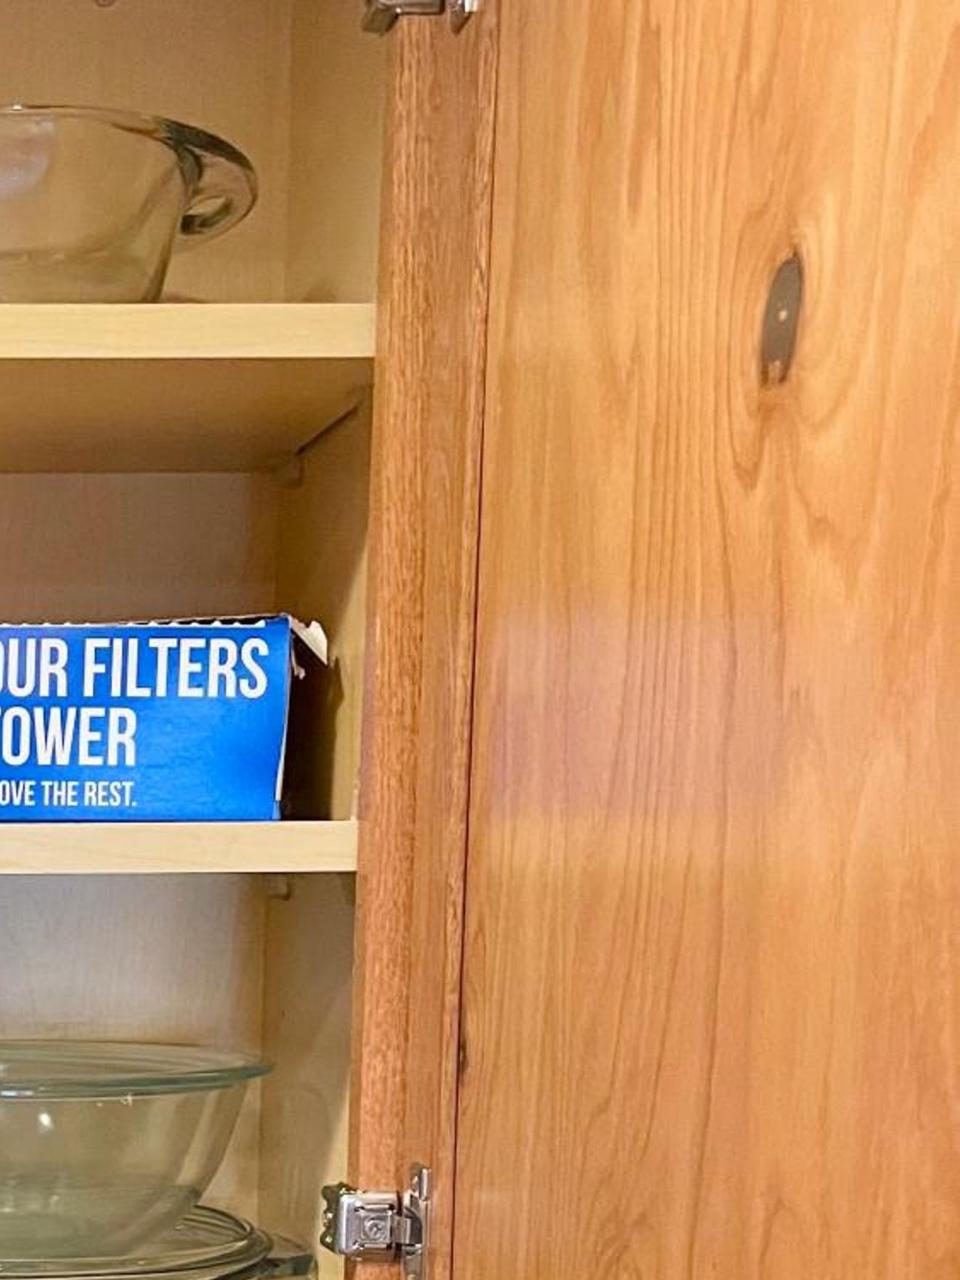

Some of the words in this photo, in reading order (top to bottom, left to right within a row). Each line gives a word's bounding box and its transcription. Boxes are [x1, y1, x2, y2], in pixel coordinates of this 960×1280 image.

[83, 638, 269, 698] FILTERS
[42, 781, 77, 807] THE
[84, 781, 137, 807] REST.
